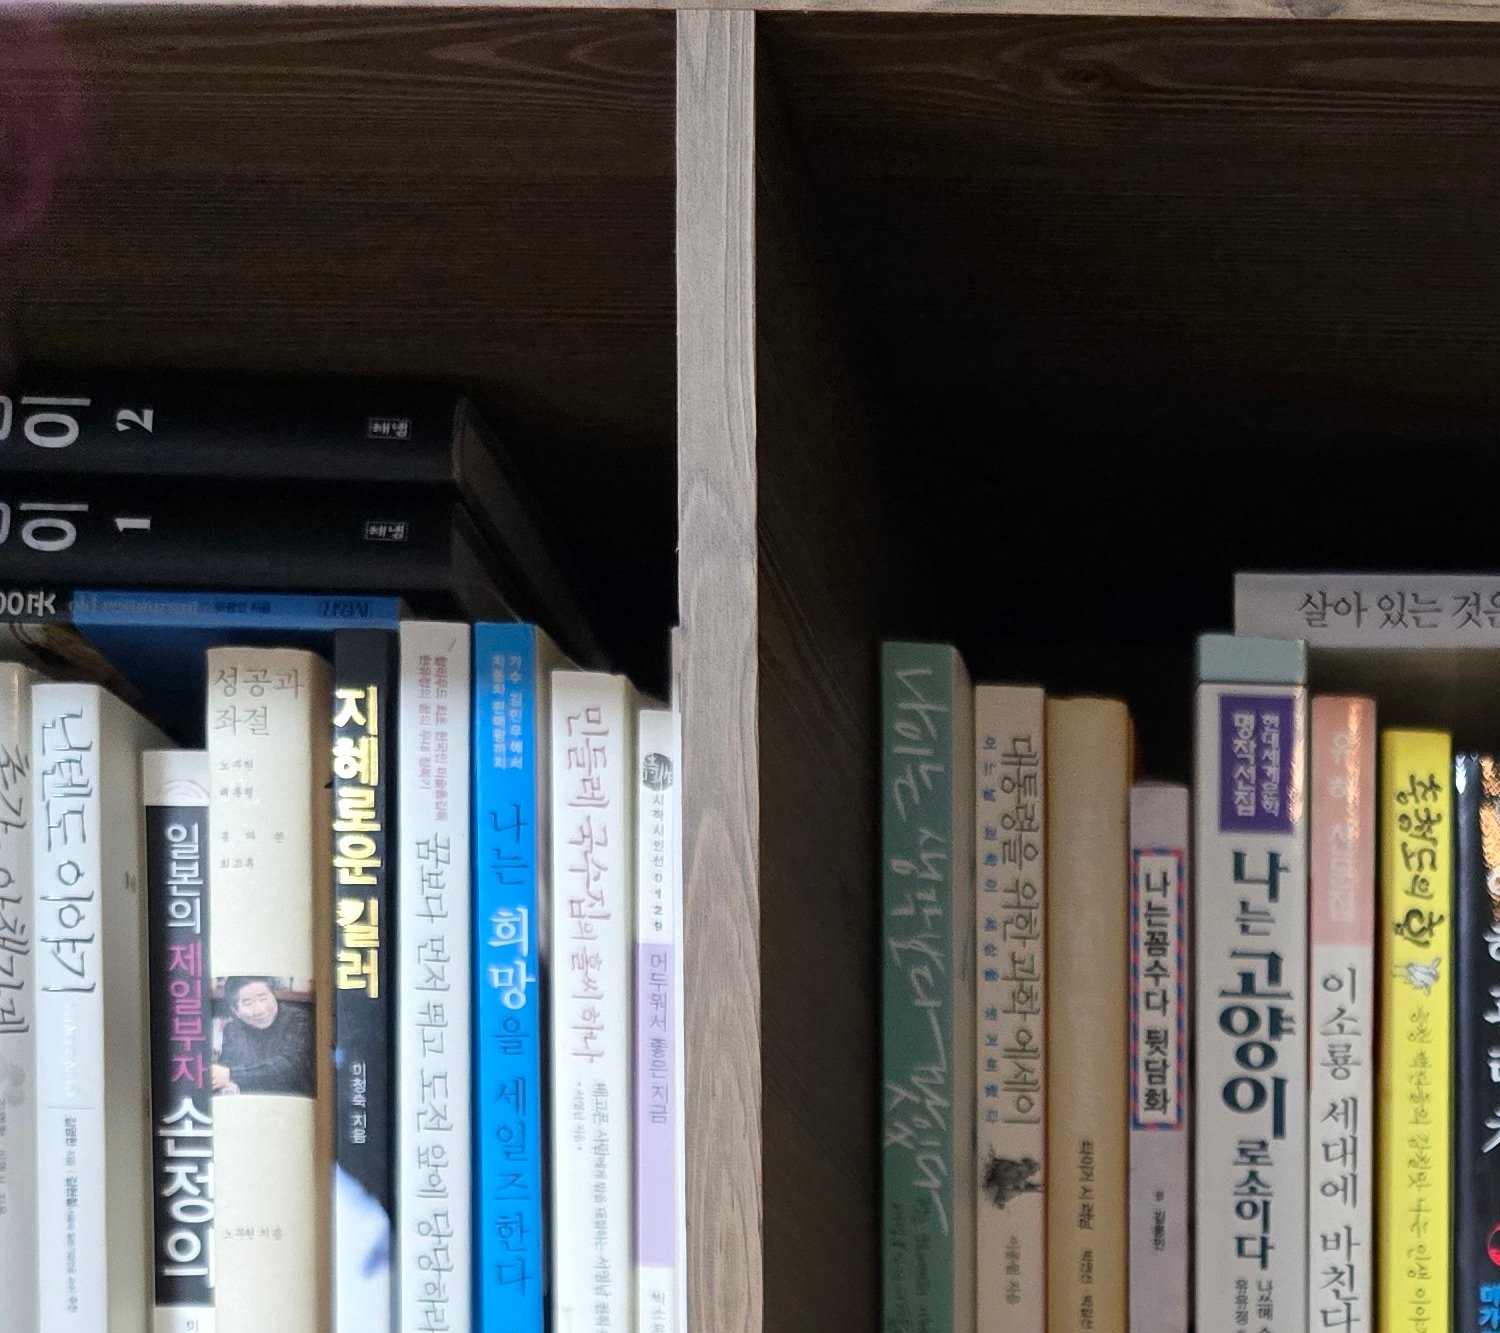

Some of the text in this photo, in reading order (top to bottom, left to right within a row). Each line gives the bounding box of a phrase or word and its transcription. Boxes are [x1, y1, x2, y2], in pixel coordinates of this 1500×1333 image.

[116, 408, 154, 433] 2
[115, 516, 151, 532] 1
[1297, 588, 1368, 630] 살아
[1376, 588, 1442, 630] 있는
[214, 667, 306, 699] 성공과
[214, 706, 271, 737] 좌절
[1232, 712, 1257, 817] 명작선집
[40, 708, 97, 994] 닌텐도 이야기
[333, 685, 379, 999] 지혜로운 킬러
[415, 831, 449, 923] 꿈보다
[1394, 771, 1442, 902] 충청도의
[487, 804, 535, 1057] 나는 희망을
[565, 706, 612, 1064] 민들레 국수집의 홀씨 하나
[999, 733, 1041, 1126] 대통령을 위한 과학 에세이
[1232, 850, 1292, 937] 나는
[415, 935, 450, 993] 먼저
[159, 822, 215, 1291] 일본의 제일부자 손정의
[416, 1002, 450, 1058] 뛰고
[649, 953, 669, 1125] 어두워서 좋은 지금
[1320, 965, 1361, 1080] 이소룡
[417, 1067, 452, 1134] 도전
[417, 1143, 450, 1199] 앞에
[1320, 1096, 1360, 1209] 세대에
[1407, 1244, 1432, 1281] 인생
